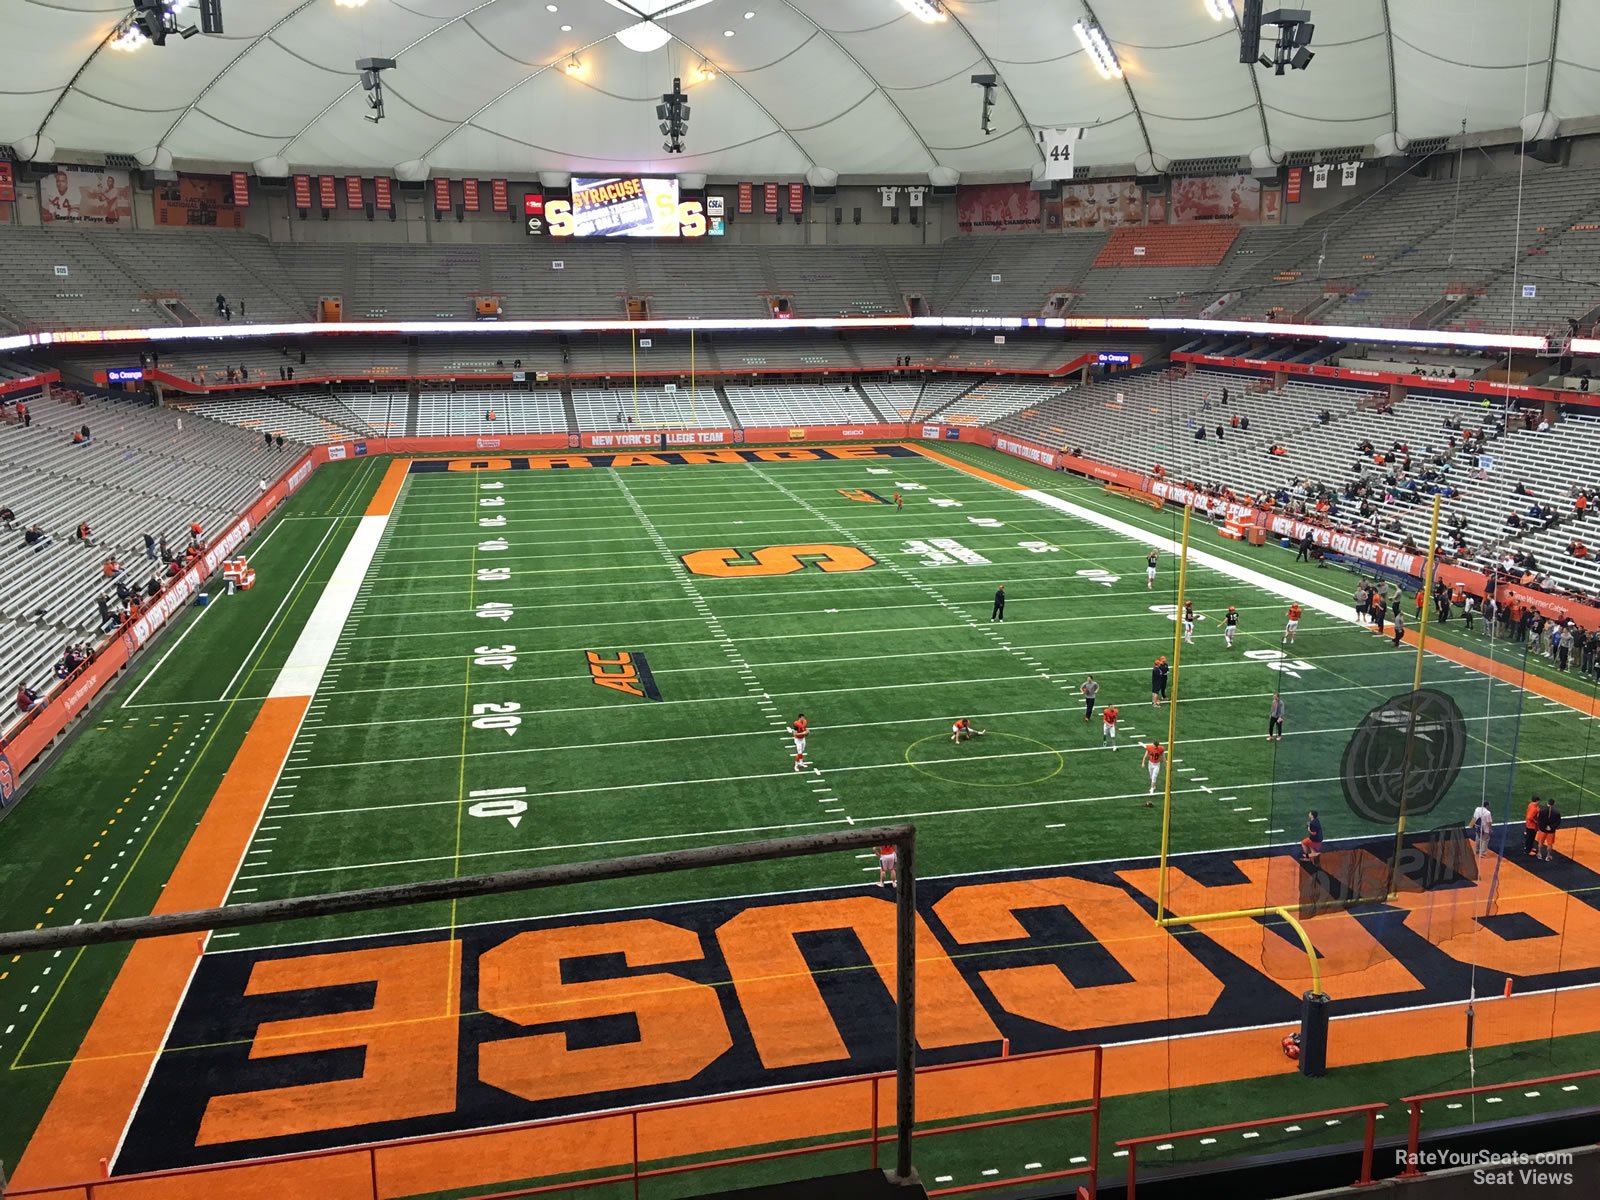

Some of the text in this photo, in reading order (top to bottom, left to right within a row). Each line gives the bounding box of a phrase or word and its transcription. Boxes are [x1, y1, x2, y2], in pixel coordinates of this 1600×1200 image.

[1050, 144, 1071, 161] 44
[1315, 173, 1326, 182] 88
[1345, 170, 1354, 179] 39
[573, 178, 642, 208] SYRACUSE
[544, 199, 574, 237] S
[679, 200, 707, 237] S
[1109, 353, 1129, 363] Orange
[108, 371, 143, 380] Go Orange
[568, 434, 580, 448] S
[592, 432, 724, 446] NEW YORK'S CLLEGE TEAM
[733, 430, 743, 443] S
[842, 429, 864, 437] GEICO
[447, 446, 893, 471] ORANGE
[1152, 481, 1168, 498] NEW
[1168, 486, 1194, 506] YORK'S
[1228, 503, 1252, 518] TEAM
[1272, 516, 1415, 574] NEW YOK'S COLLEGE TEAM
[680, 543, 879, 579] S
[476, 567, 512, 581] 50
[165, 580, 190, 614] COLLEGE
[185, 566, 201, 592] TEAM
[475, 601, 514, 619] 40
[473, 644, 517, 666] 30
[1243, 649, 1317, 671] 20
[585, 650, 646, 698] ACC
[471, 701, 522, 732] 20
[468, 785, 528, 818] 10
